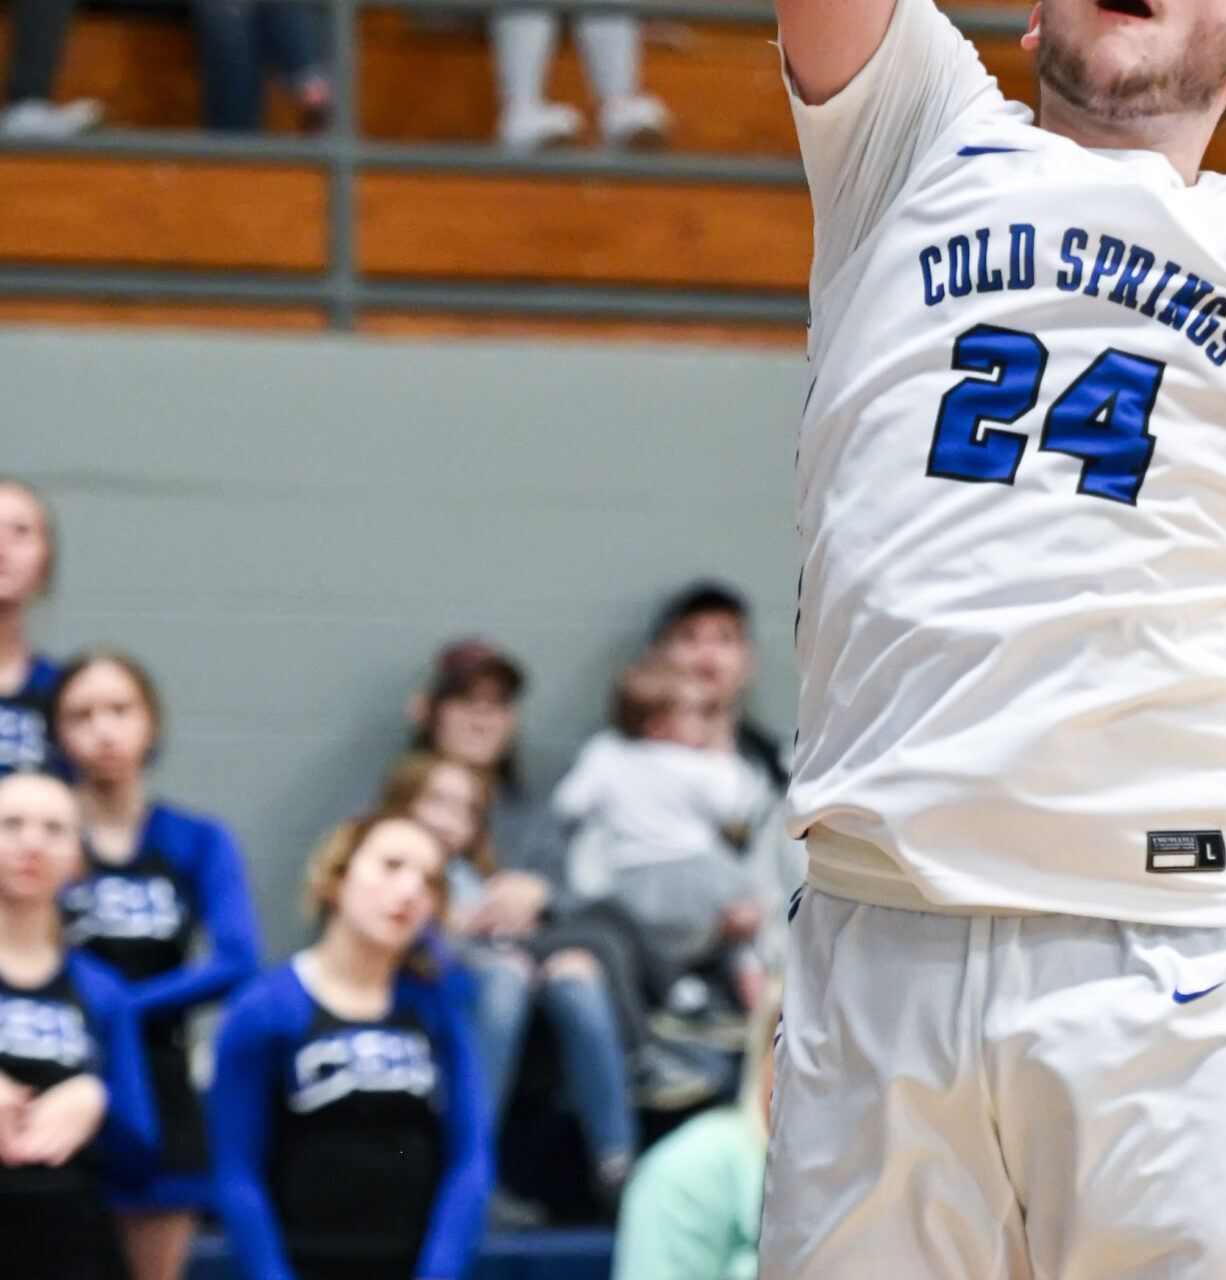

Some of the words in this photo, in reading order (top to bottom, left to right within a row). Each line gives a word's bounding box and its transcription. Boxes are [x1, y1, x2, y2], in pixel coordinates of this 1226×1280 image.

[919, 223, 1035, 307] COLD
[925, 322, 1167, 507] 24
[1205, 842, 1217, 860] L
